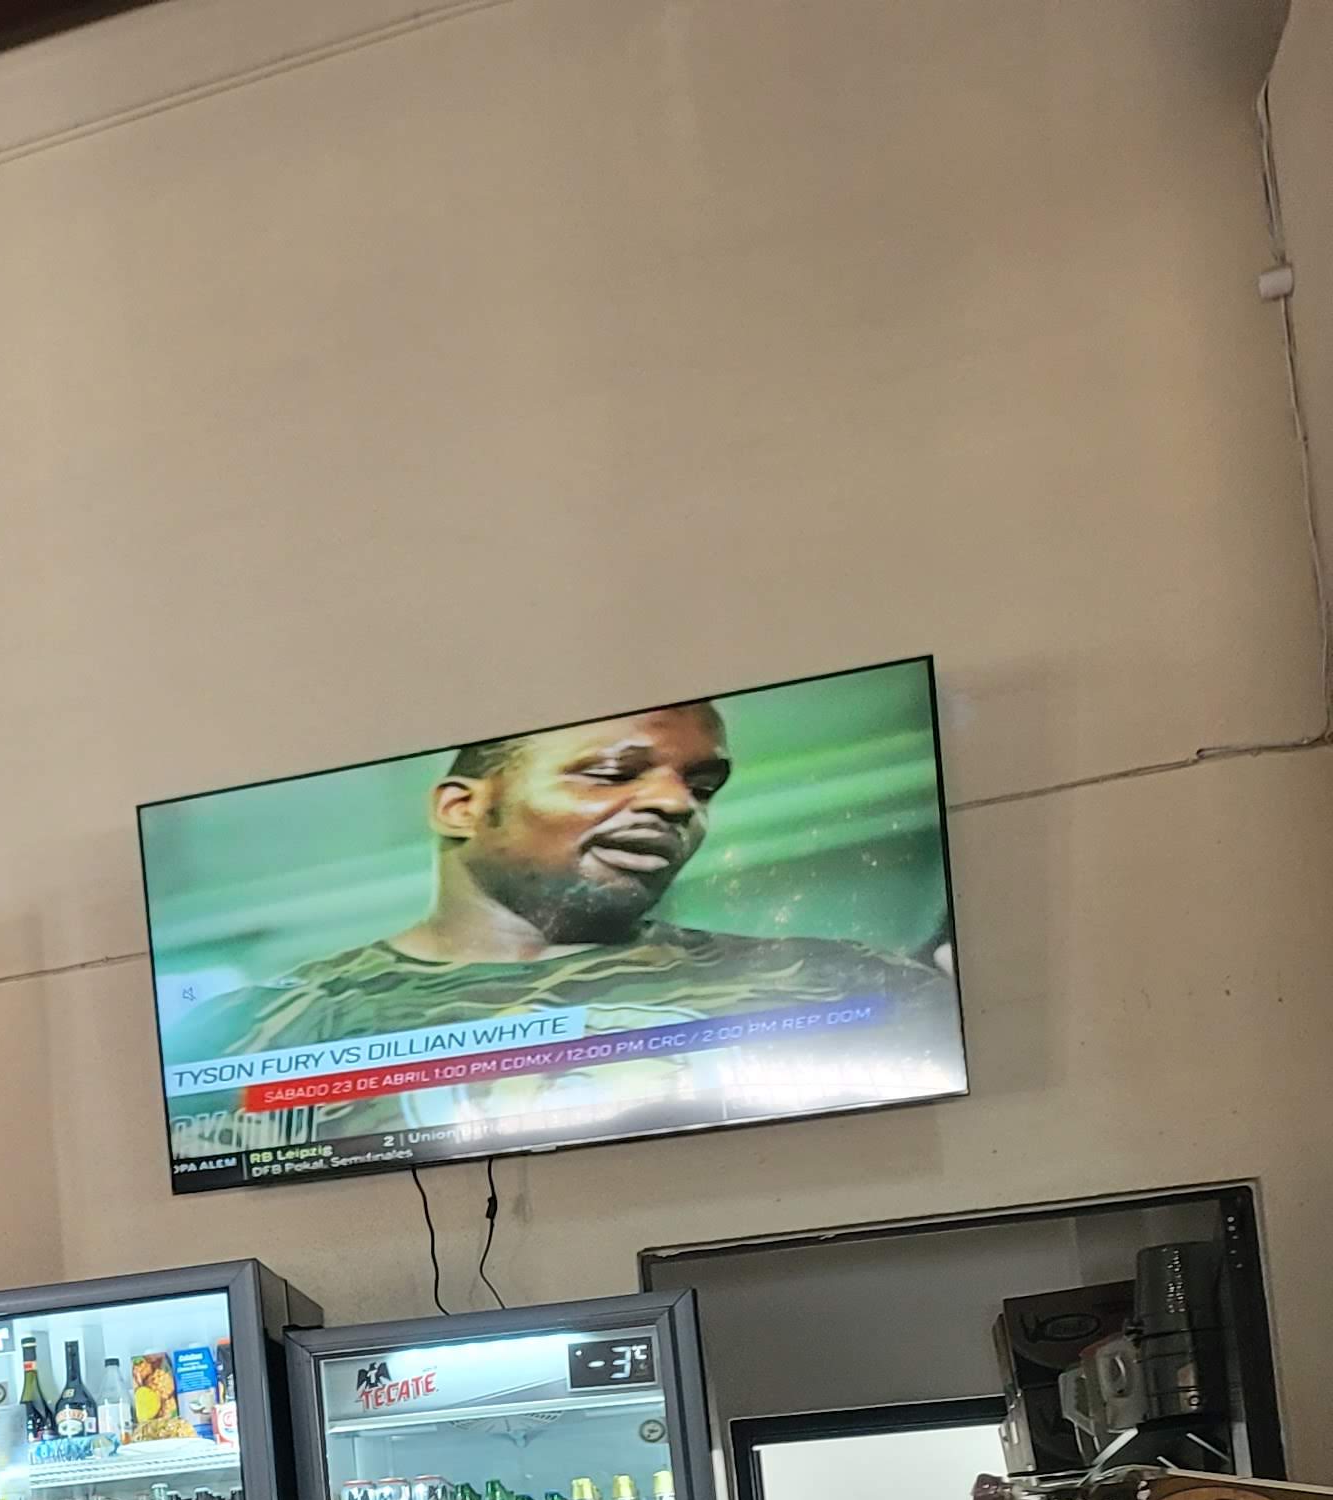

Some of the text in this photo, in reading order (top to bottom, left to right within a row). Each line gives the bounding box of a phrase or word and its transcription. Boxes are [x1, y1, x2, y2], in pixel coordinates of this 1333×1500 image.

[174, 1016, 570, 1088] TYSON FURY VS DILLIAN WHYTE
[331, 1079, 353, 1094] 23
[356, 1077, 379, 1091] DE
[382, 1070, 430, 1087] ABRIL
[434, 1064, 465, 1079] 1:00
[469, 1060, 497, 1075] PM
[500, 1053, 552, 1071] CDMX
[566, 1044, 612, 1062] 12:00
[615, 1039, 645, 1054] PM
[647, 1033, 686, 1050] CRC
[701, 1025, 743, 1042] 2:00
[747, 1020, 778, 1035] PM
[249, 1135, 395, 1164] RB Leipzig 2
[408, 1129, 455, 1144] Union
[251, 1163, 283, 1177] DFB
[359, 1371, 438, 1411] TECATE
